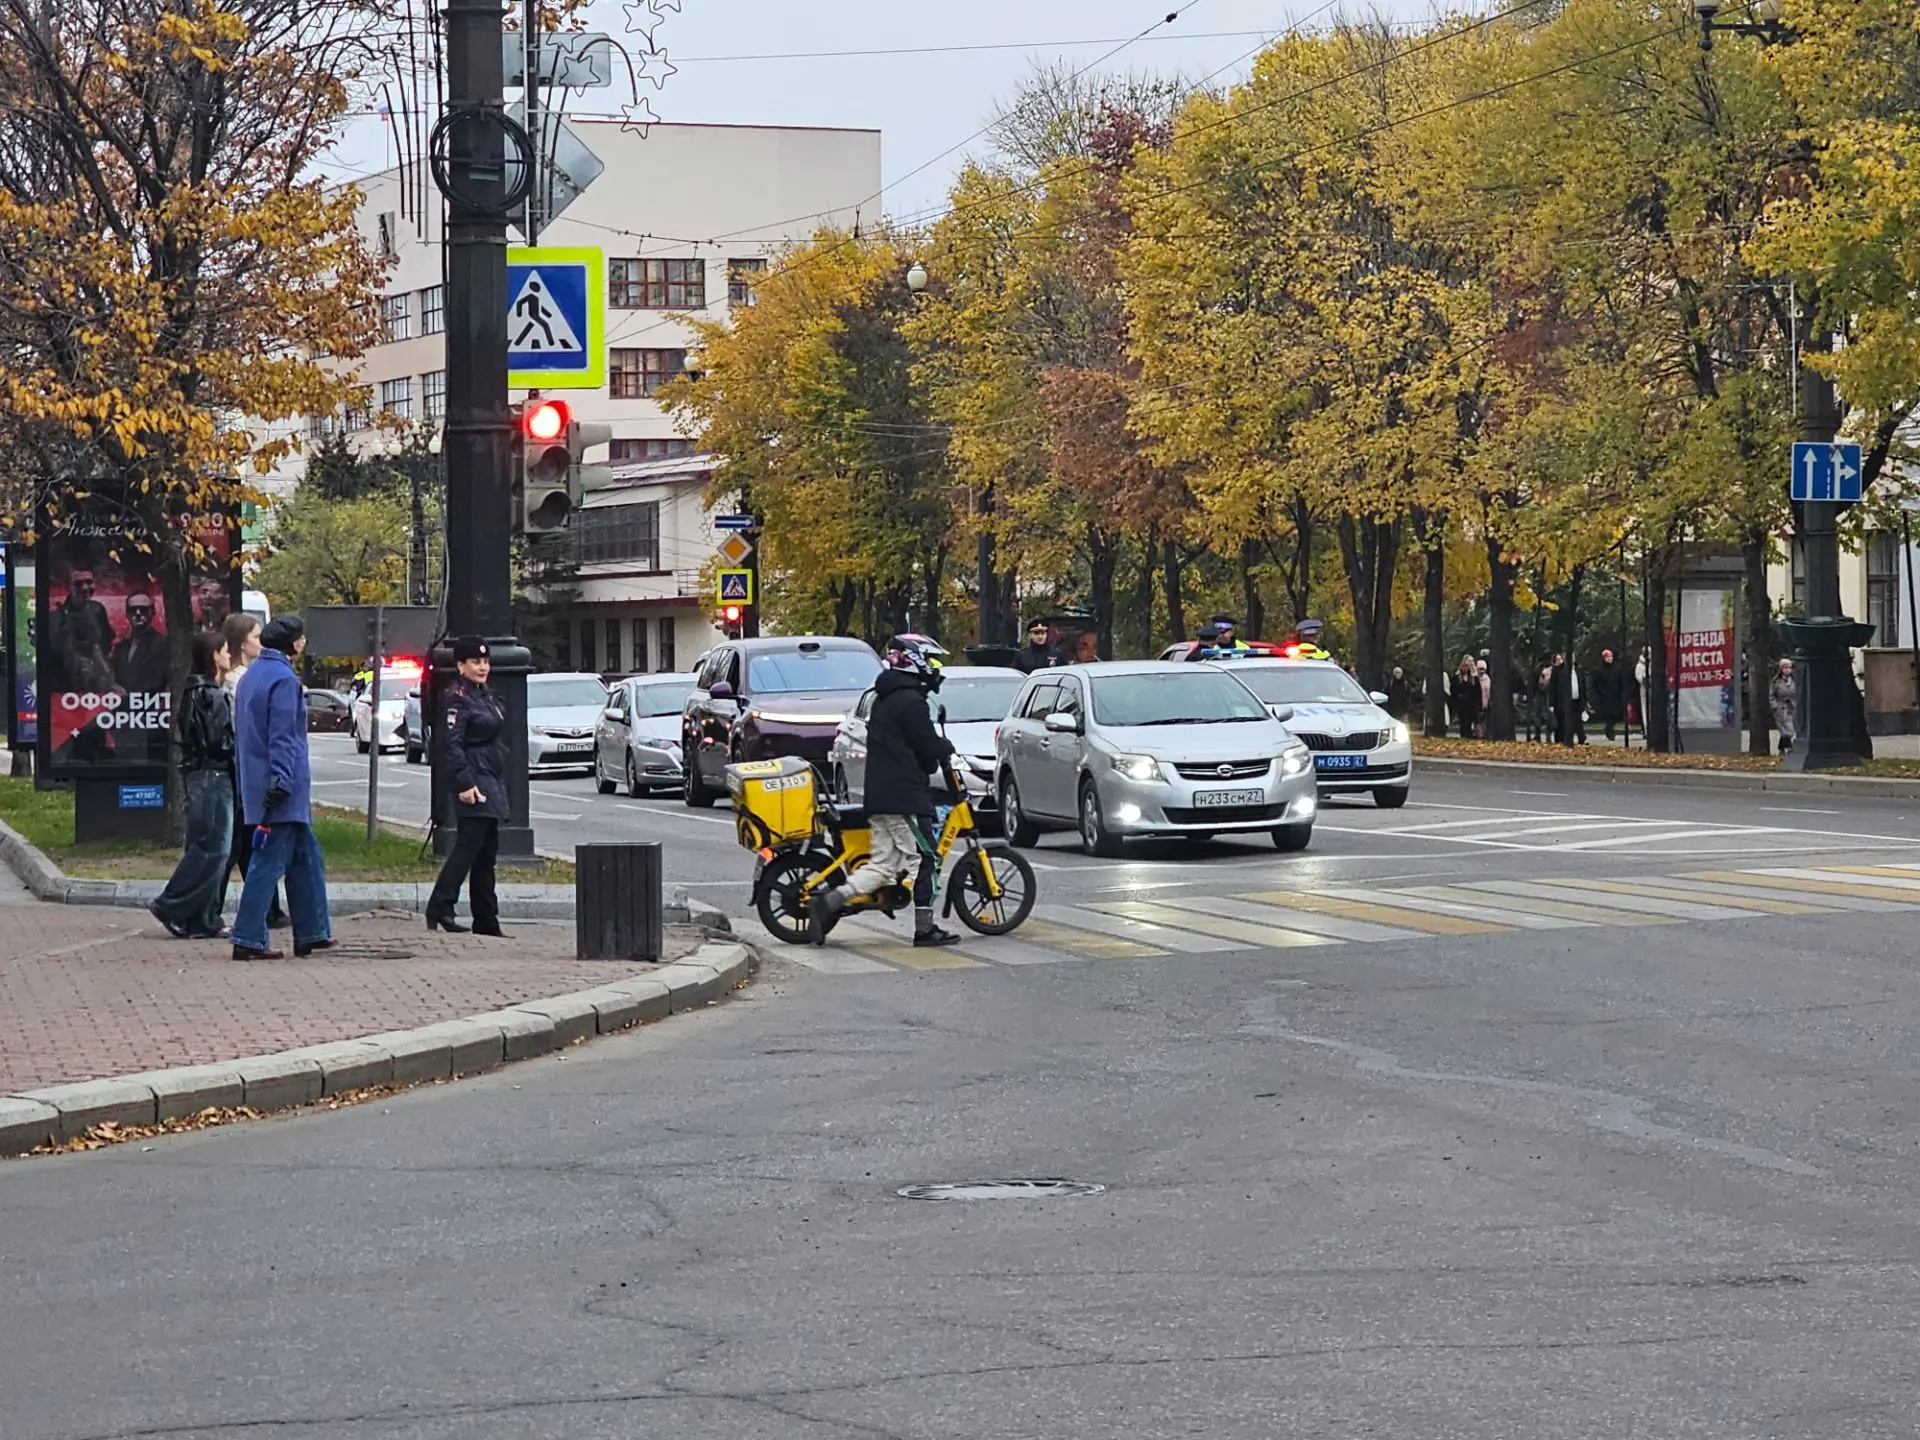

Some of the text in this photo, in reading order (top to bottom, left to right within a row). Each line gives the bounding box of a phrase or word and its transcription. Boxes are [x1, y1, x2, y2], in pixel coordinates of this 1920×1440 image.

[1681, 650, 1724, 668] МЕСТА
[61, 692, 122, 711] ОФФ
[1327, 756, 1351, 767] 0935
